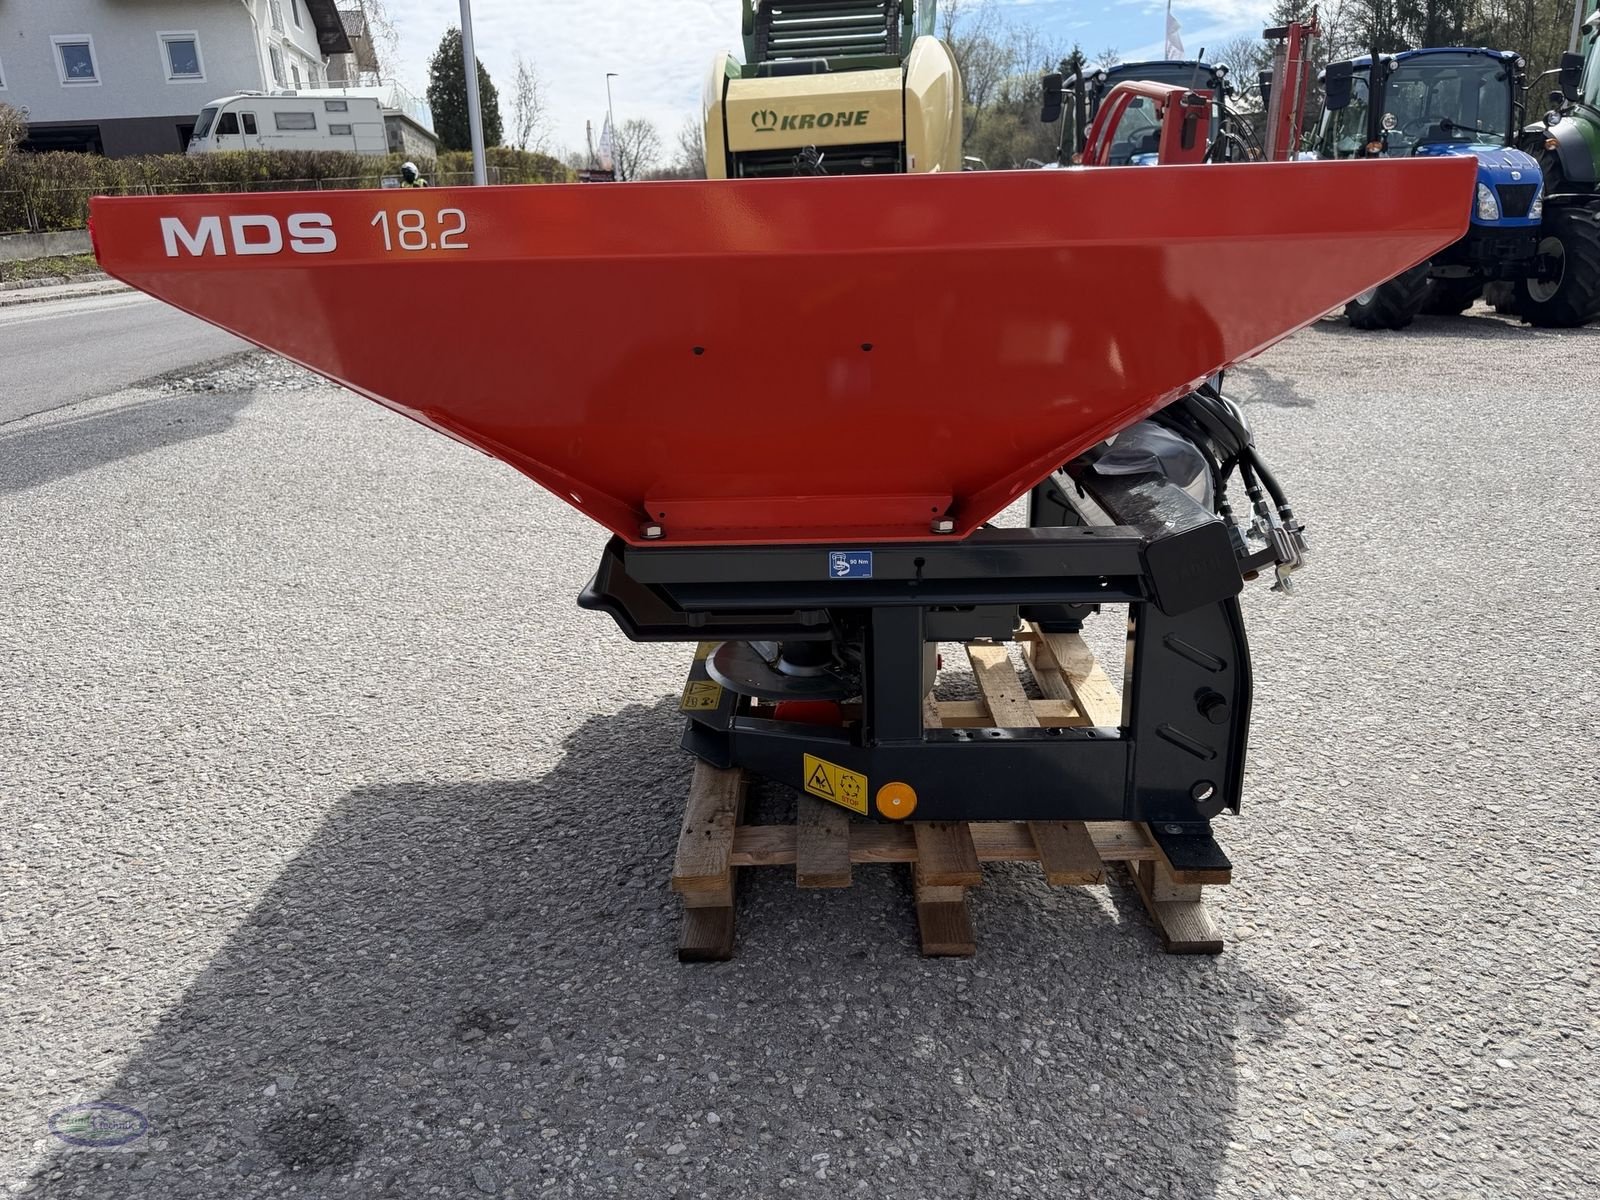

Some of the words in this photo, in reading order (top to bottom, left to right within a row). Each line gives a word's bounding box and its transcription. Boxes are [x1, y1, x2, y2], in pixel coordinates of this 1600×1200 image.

[780, 110, 870, 130] KRONE
[160, 213, 337, 257] MDS
[371, 208, 469, 251] 18.2
[842, 795, 859, 806] STOP
